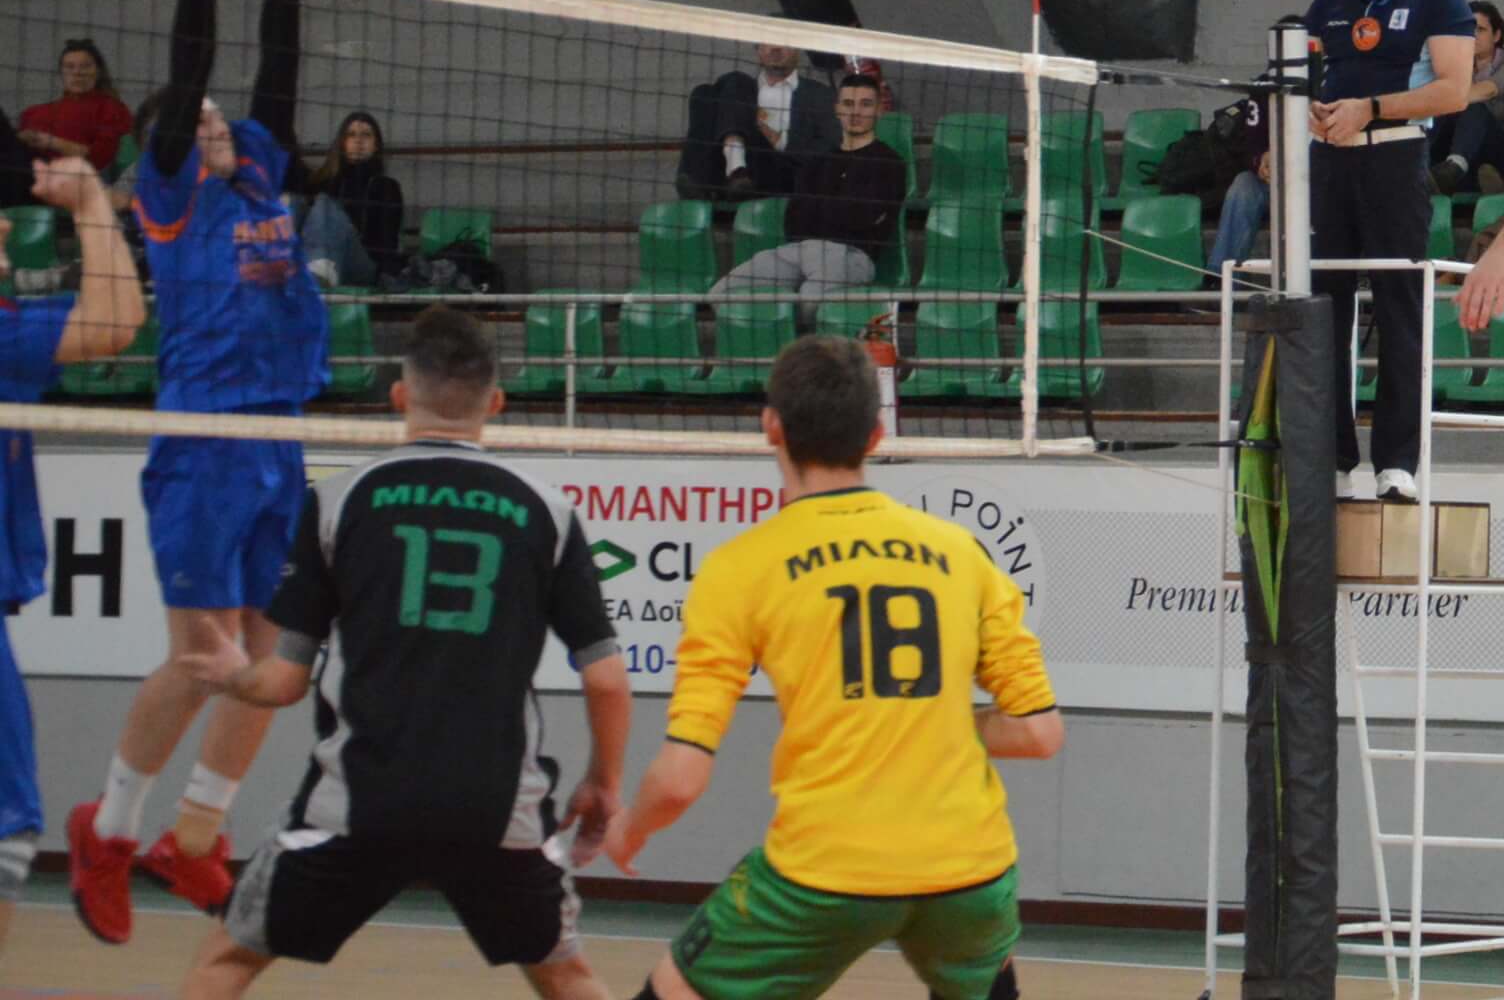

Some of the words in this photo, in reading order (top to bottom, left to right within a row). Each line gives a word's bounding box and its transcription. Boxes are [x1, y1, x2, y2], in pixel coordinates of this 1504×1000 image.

[1246, 99, 1260, 127] 3
[371, 483, 529, 528] ΜΙΛΩΝ
[392, 524, 503, 635] 13
[784, 539, 951, 582] ΜΙΛΩΝ
[1126, 576, 1249, 614] Premiu
[825, 583, 943, 701] 18
